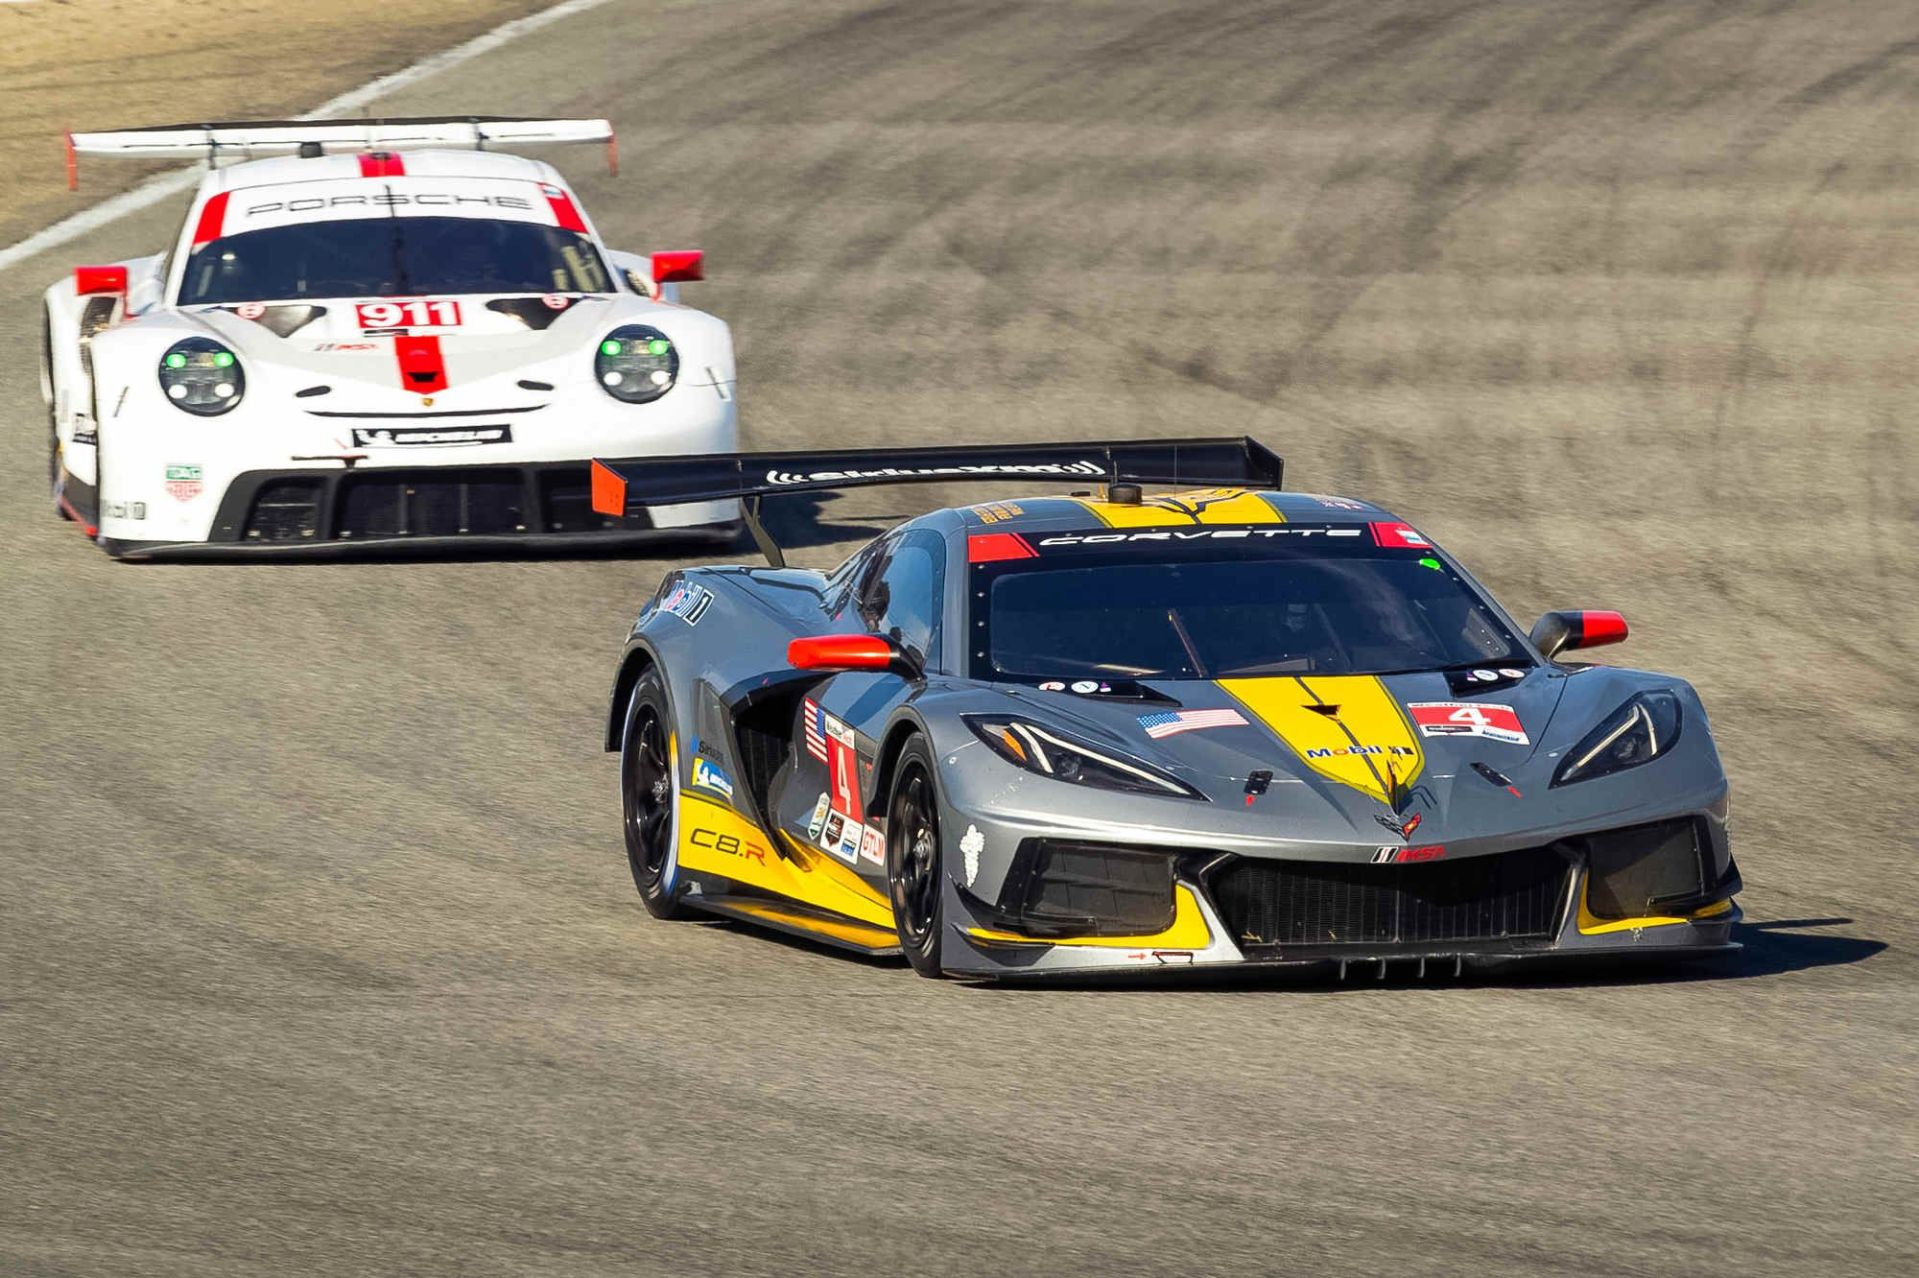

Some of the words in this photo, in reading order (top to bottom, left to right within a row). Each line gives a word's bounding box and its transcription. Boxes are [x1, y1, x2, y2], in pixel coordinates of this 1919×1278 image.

[246, 193, 533, 216] PORSCHE
[360, 302, 458, 327] 911
[1039, 528, 1363, 546] CORVETTE
[1448, 707, 1492, 725] 4
[1306, 745, 1383, 758] Mobil
[837, 746, 851, 816] 4
[690, 828, 766, 867] C8.R
